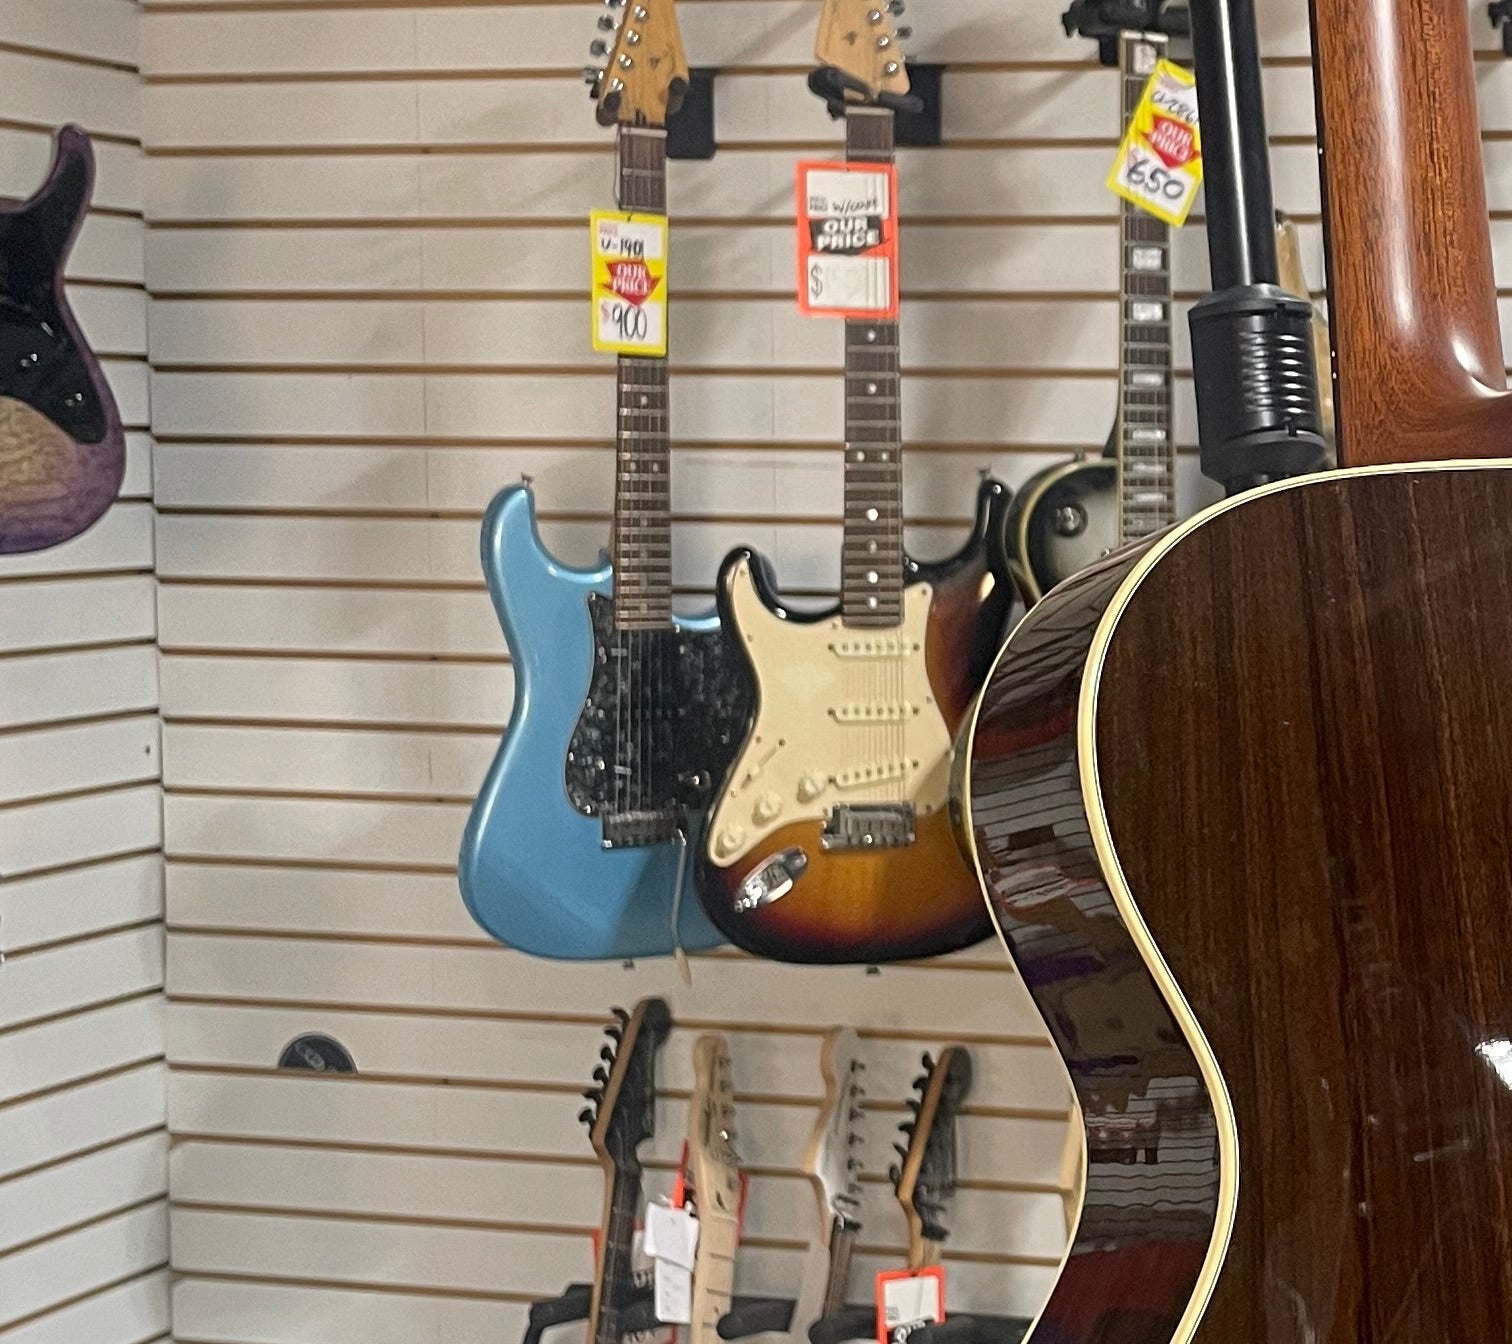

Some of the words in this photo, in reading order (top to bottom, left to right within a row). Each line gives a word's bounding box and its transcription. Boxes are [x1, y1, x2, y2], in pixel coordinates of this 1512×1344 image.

[823, 215, 869, 234] OUR
[816, 230, 880, 252] PRICE
[616, 263, 647, 278] OUR
[613, 277, 648, 296] PRICE
